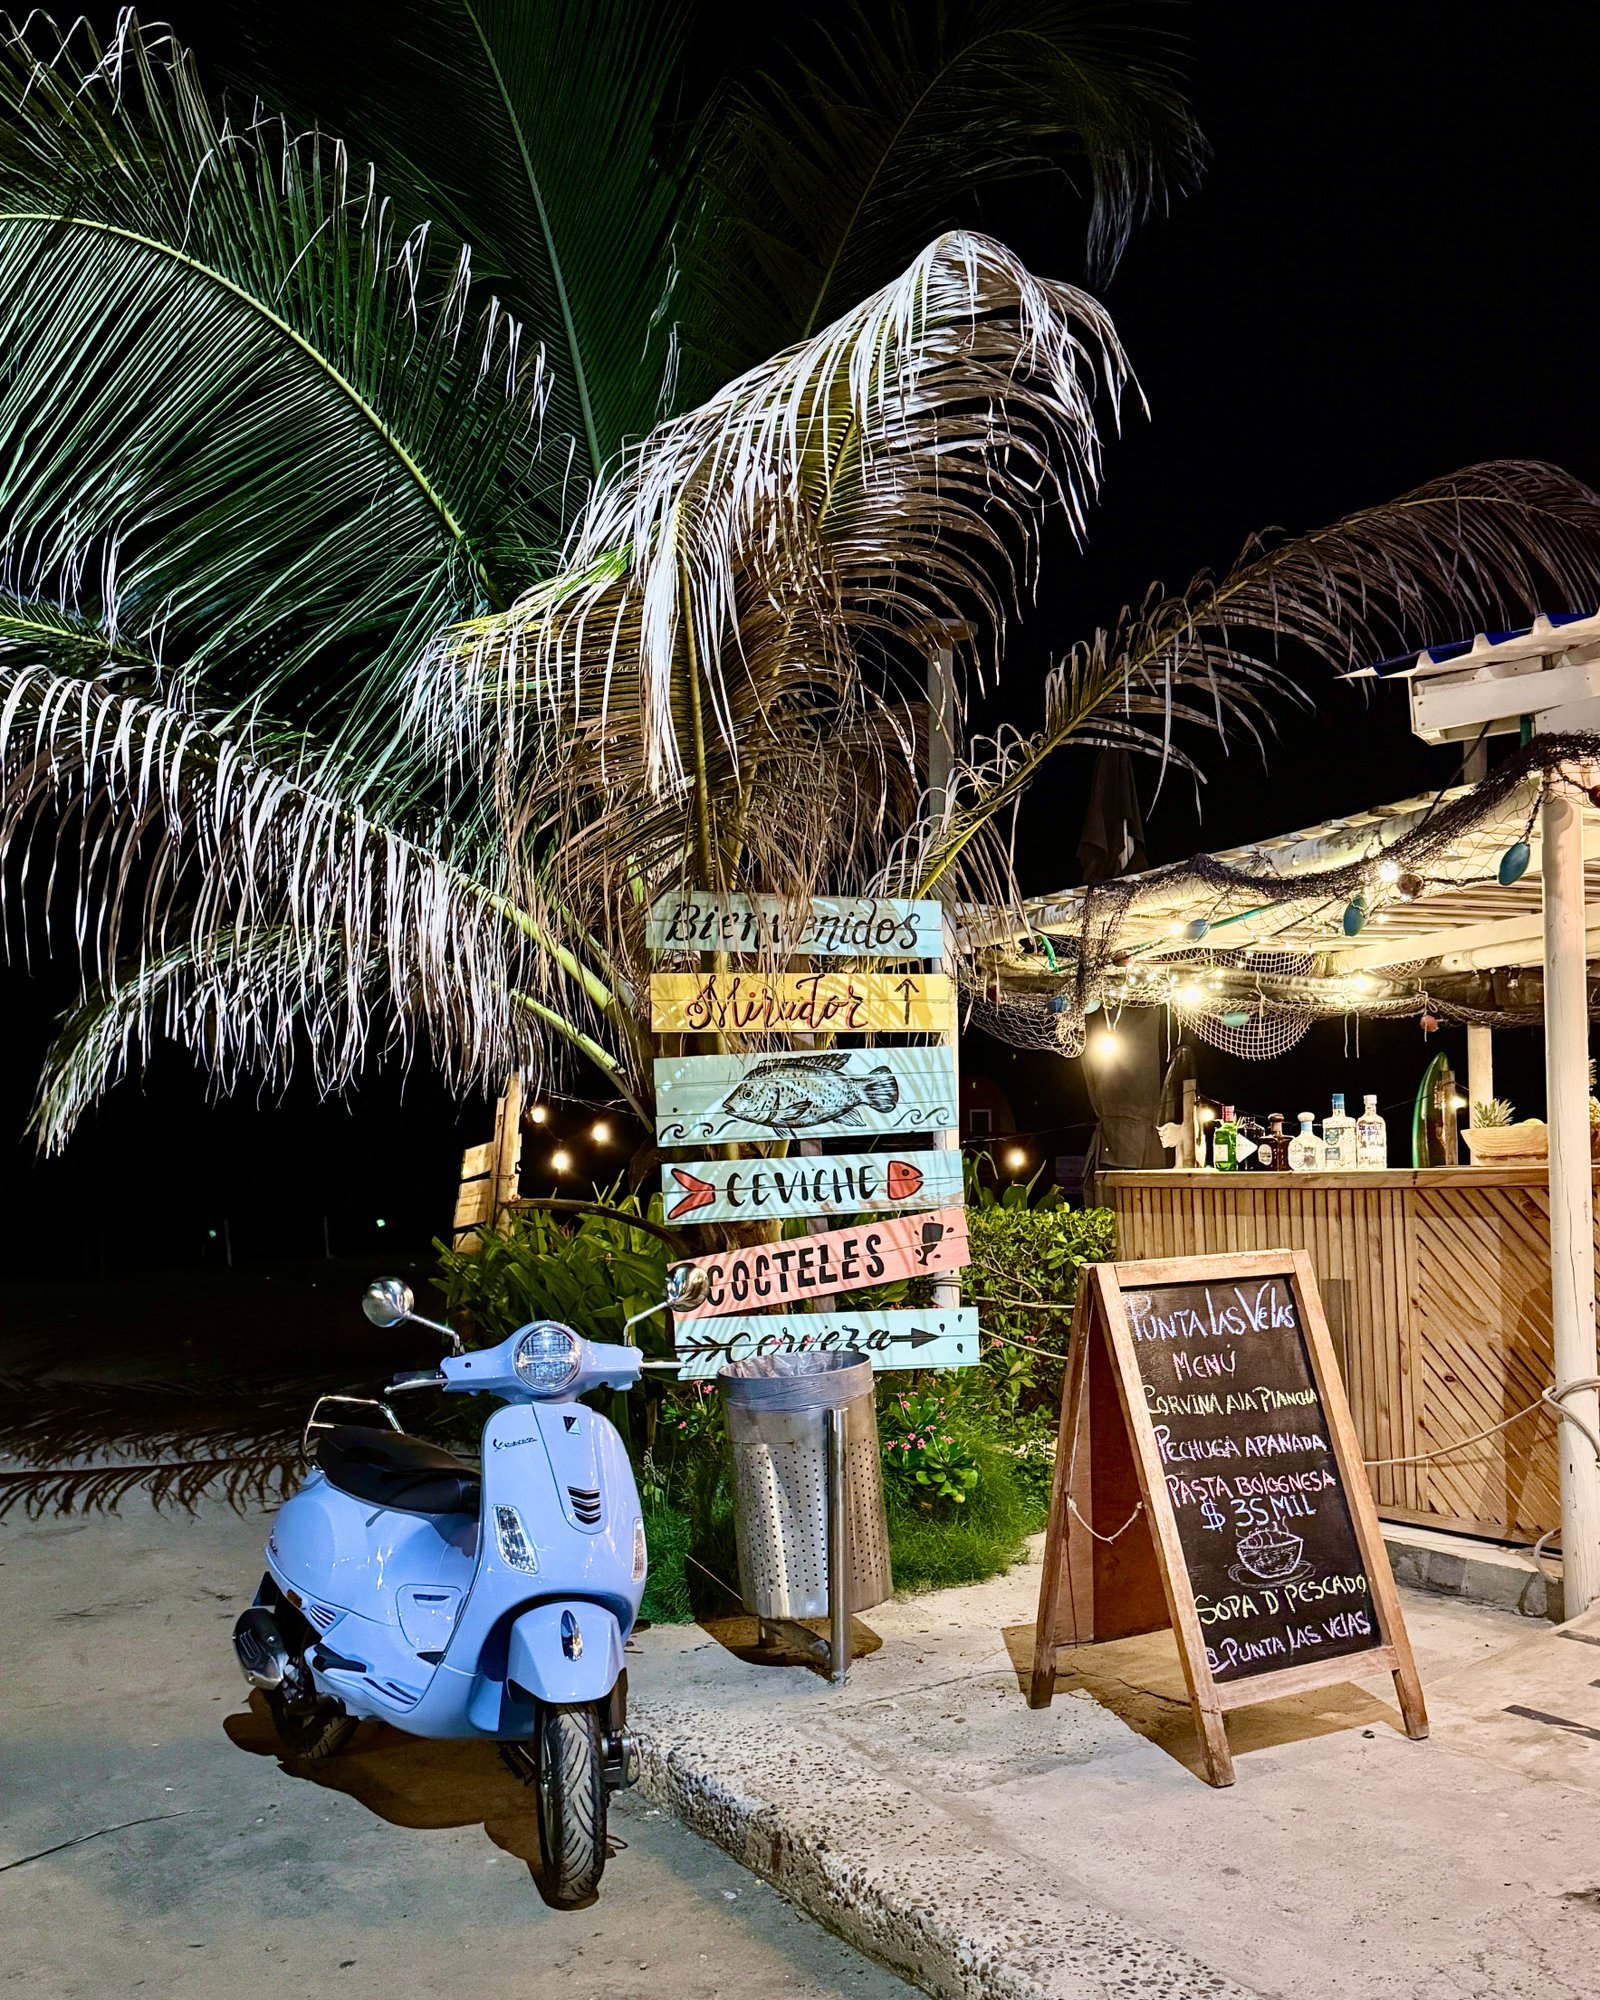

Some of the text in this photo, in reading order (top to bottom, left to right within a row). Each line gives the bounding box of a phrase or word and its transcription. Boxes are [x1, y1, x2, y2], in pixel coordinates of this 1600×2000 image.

[726, 1165, 879, 1208] CEVICHE
[707, 1234, 885, 1307] COCTELES
[1128, 1292, 1208, 1342] PUNTA
[1245, 1432, 1328, 1458] APANADA
[1164, 1474, 1234, 1508] PASTA
[1194, 1594, 1260, 1625] SOPA
[1284, 1574, 1367, 1613] PESCADO
